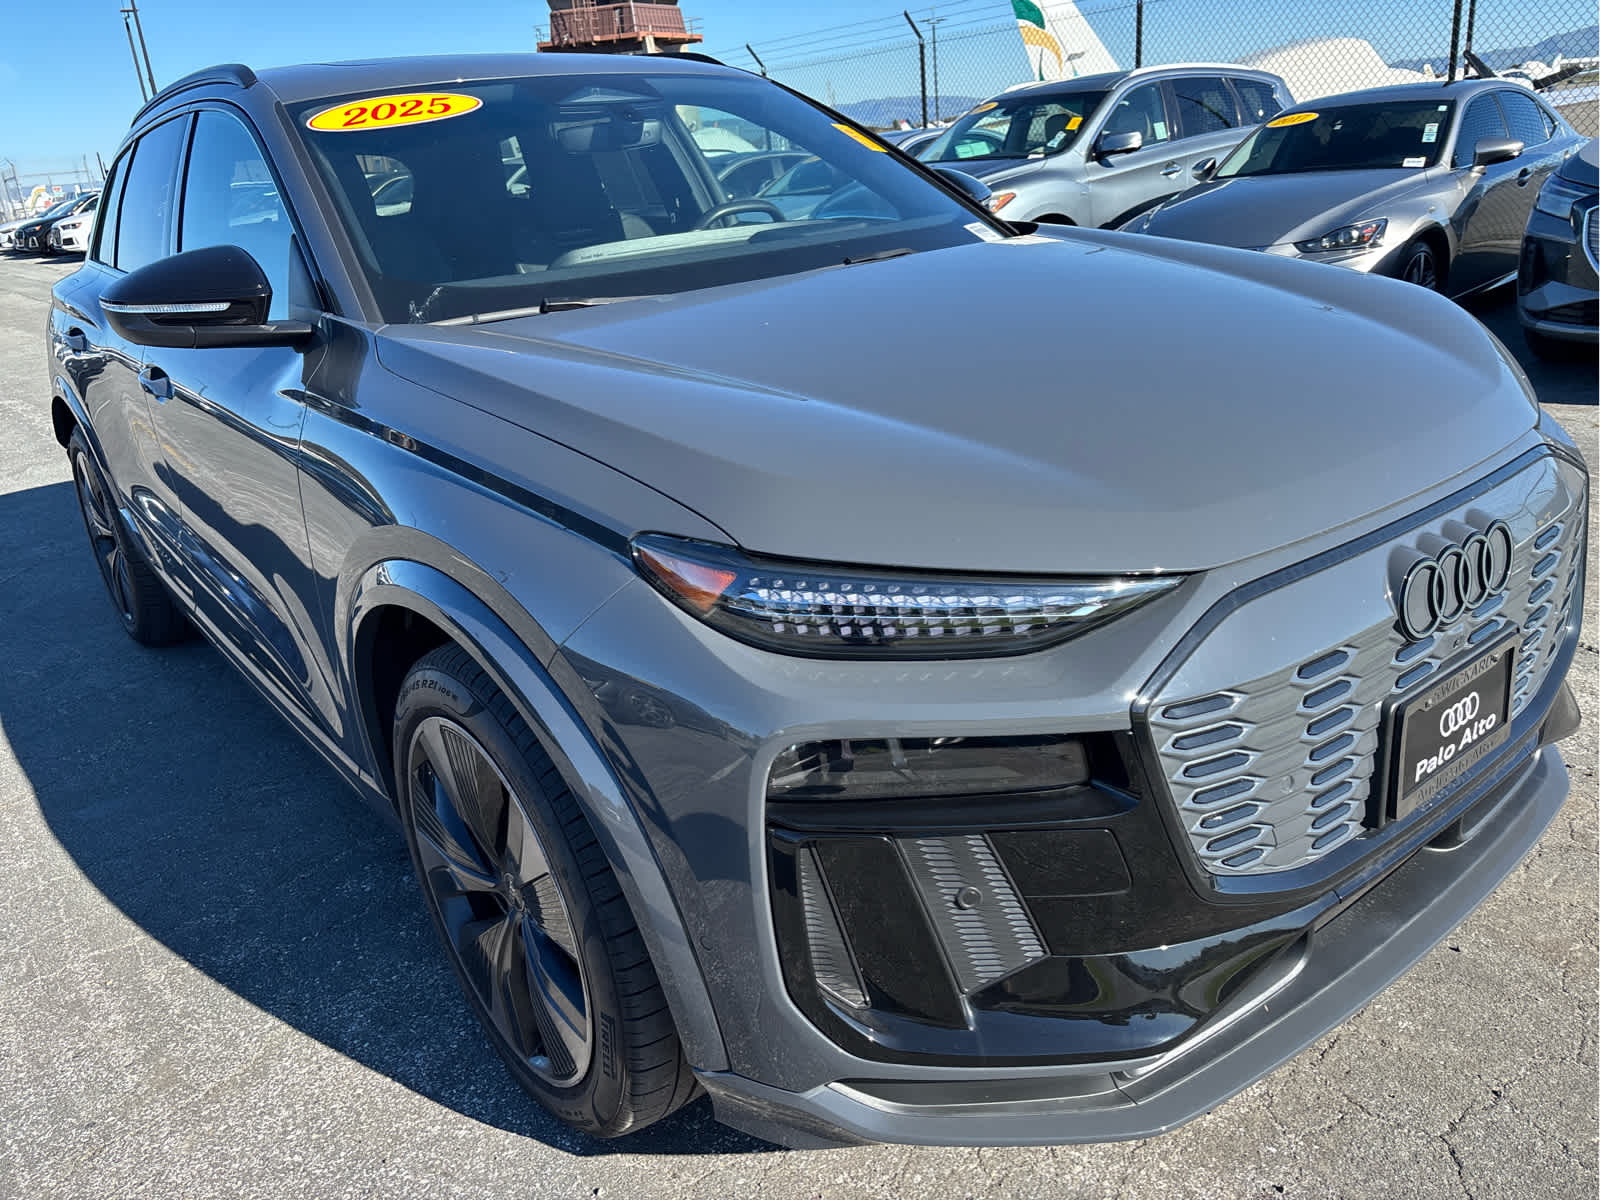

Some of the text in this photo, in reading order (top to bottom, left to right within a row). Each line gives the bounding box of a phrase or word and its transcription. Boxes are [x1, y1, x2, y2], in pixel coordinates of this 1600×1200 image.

[342, 97, 451, 127] 2025
[422, 680, 439, 690] R21
[1415, 713, 1496, 783] Palo Alto
